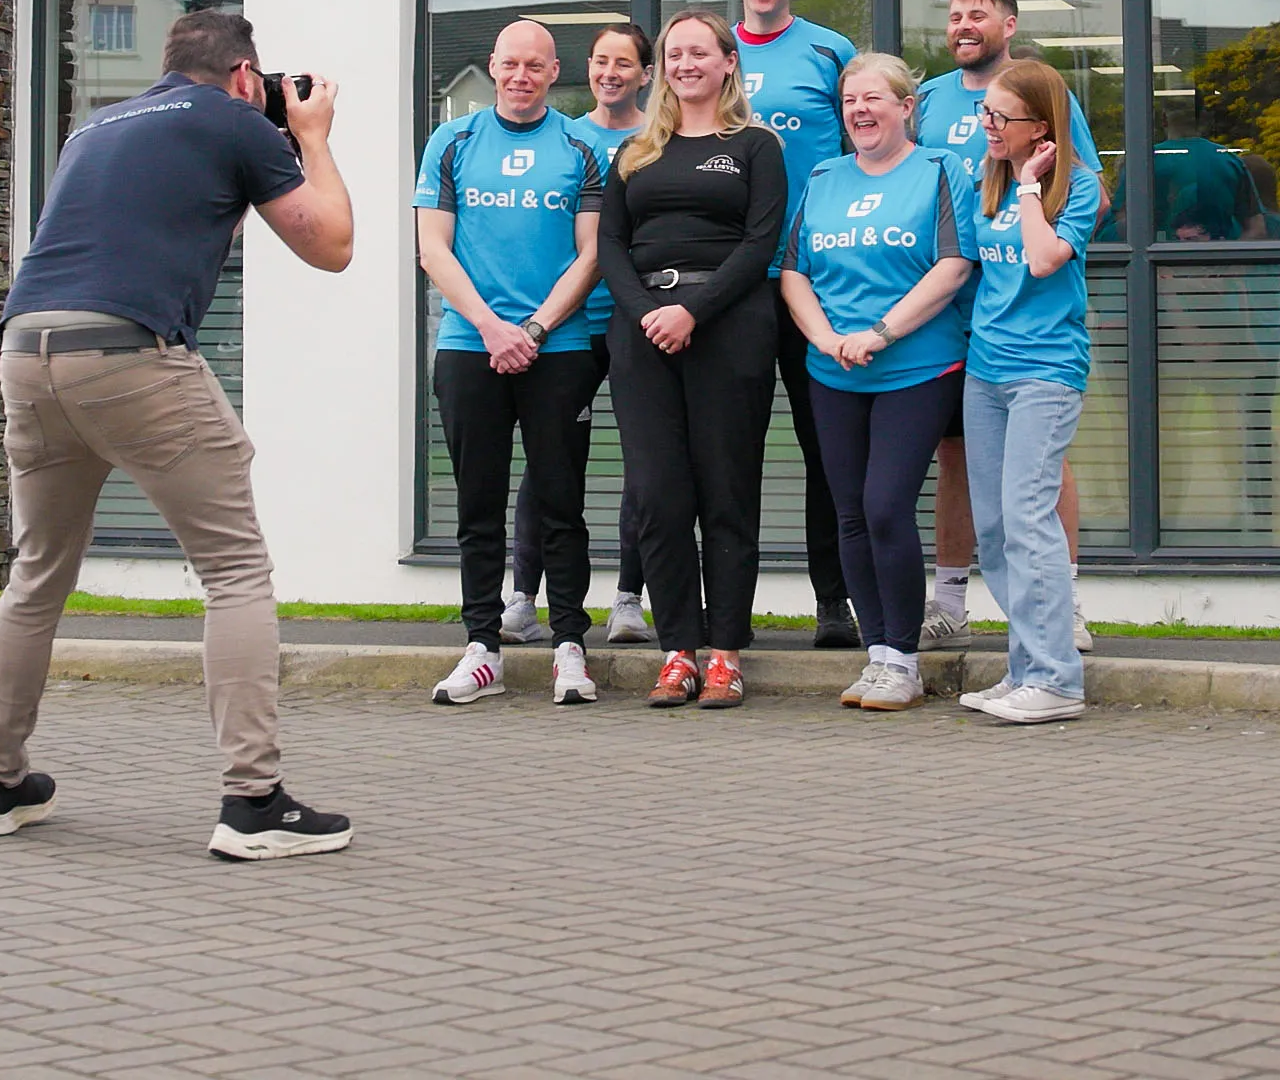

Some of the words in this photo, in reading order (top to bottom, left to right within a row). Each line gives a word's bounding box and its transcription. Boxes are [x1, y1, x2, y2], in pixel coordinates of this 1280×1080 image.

[770, 111, 801, 131] Co
[465, 188, 516, 208] Boal
[521, 189, 538, 209] &
[544, 190, 569, 211] Co
[812, 227, 857, 253] Boal
[862, 226, 878, 246] &
[883, 226, 917, 248] Co
[979, 243, 1003, 263] oal
[1005, 245, 1018, 264] &
